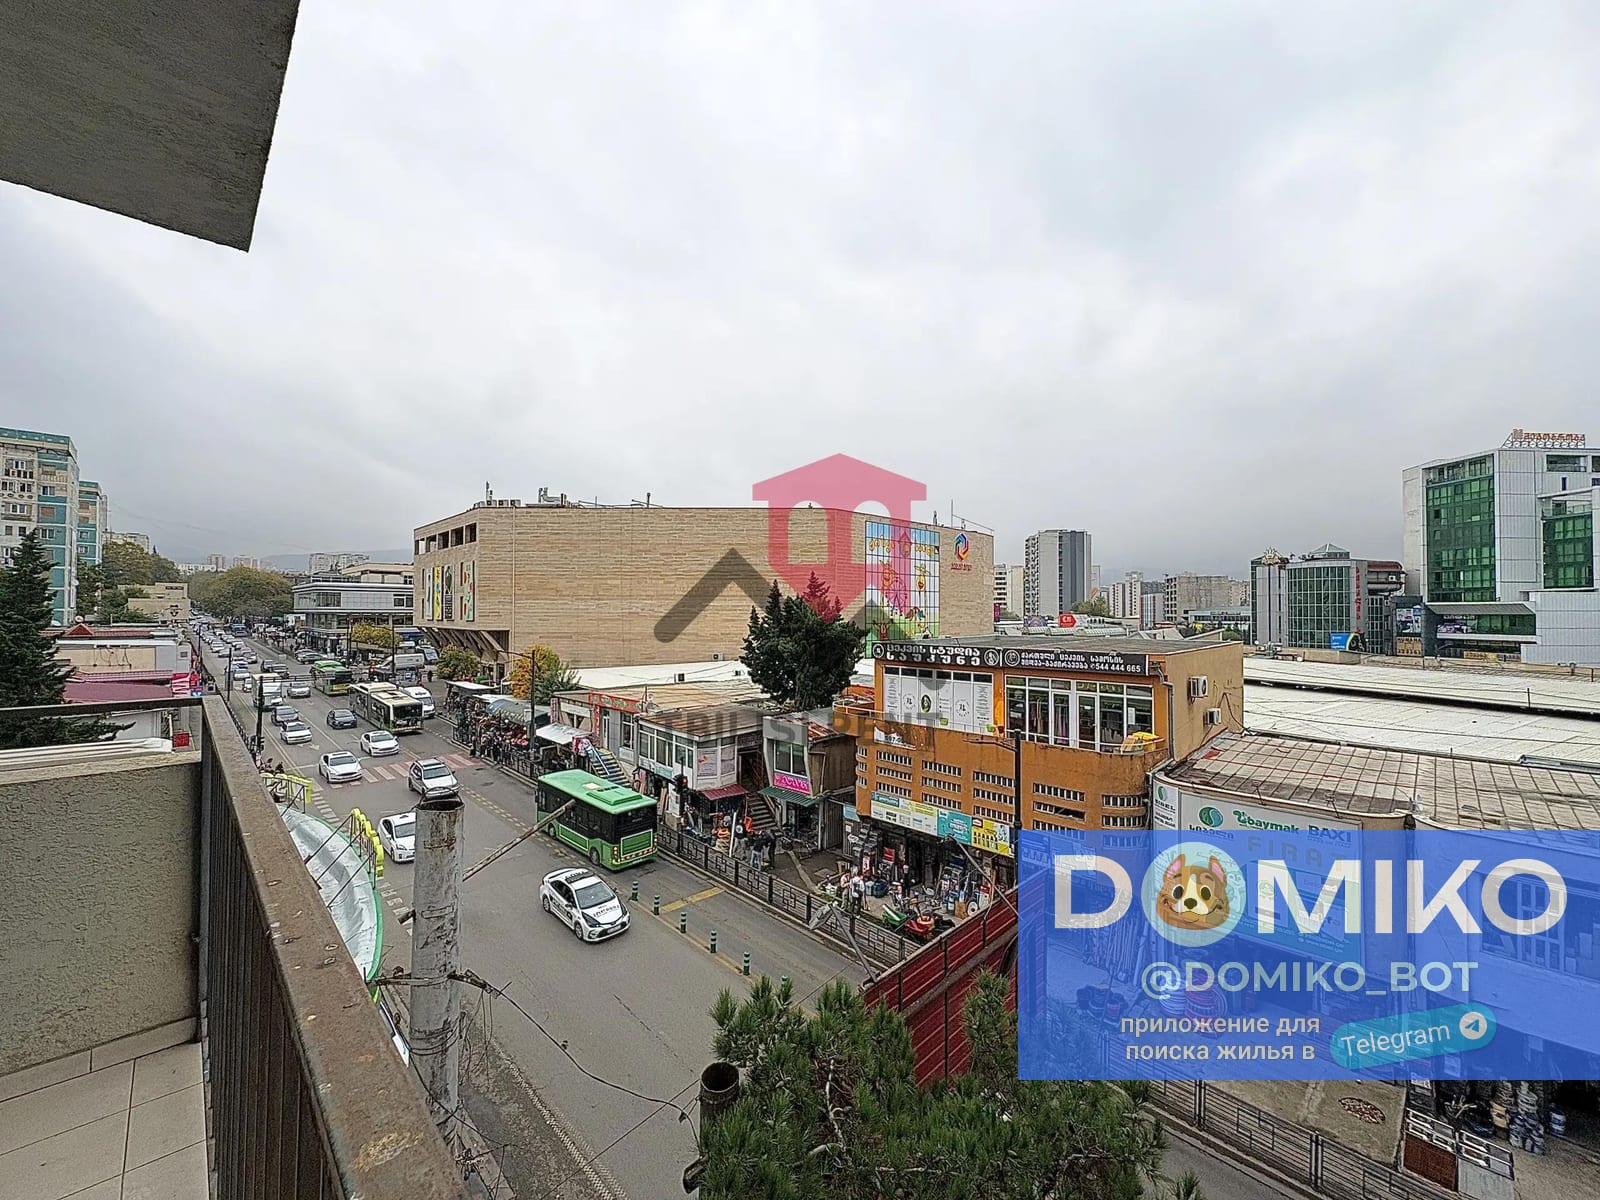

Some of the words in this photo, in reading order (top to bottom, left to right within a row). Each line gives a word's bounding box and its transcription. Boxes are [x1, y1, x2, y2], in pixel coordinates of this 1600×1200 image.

[886, 643, 926, 654] ცეკვის
[929, 646, 981, 657] სტუდია
[886, 652, 981, 666] საუკუნე
[1021, 652, 1055, 661] ქართული
[1059, 653, 1086, 662] ცეკვის
[1089, 655, 1124, 664] სამოსის
[1110, 664, 1125, 672] 444
[1246, 814, 1300, 836] baymak
[1308, 824, 1352, 842] BAXI
